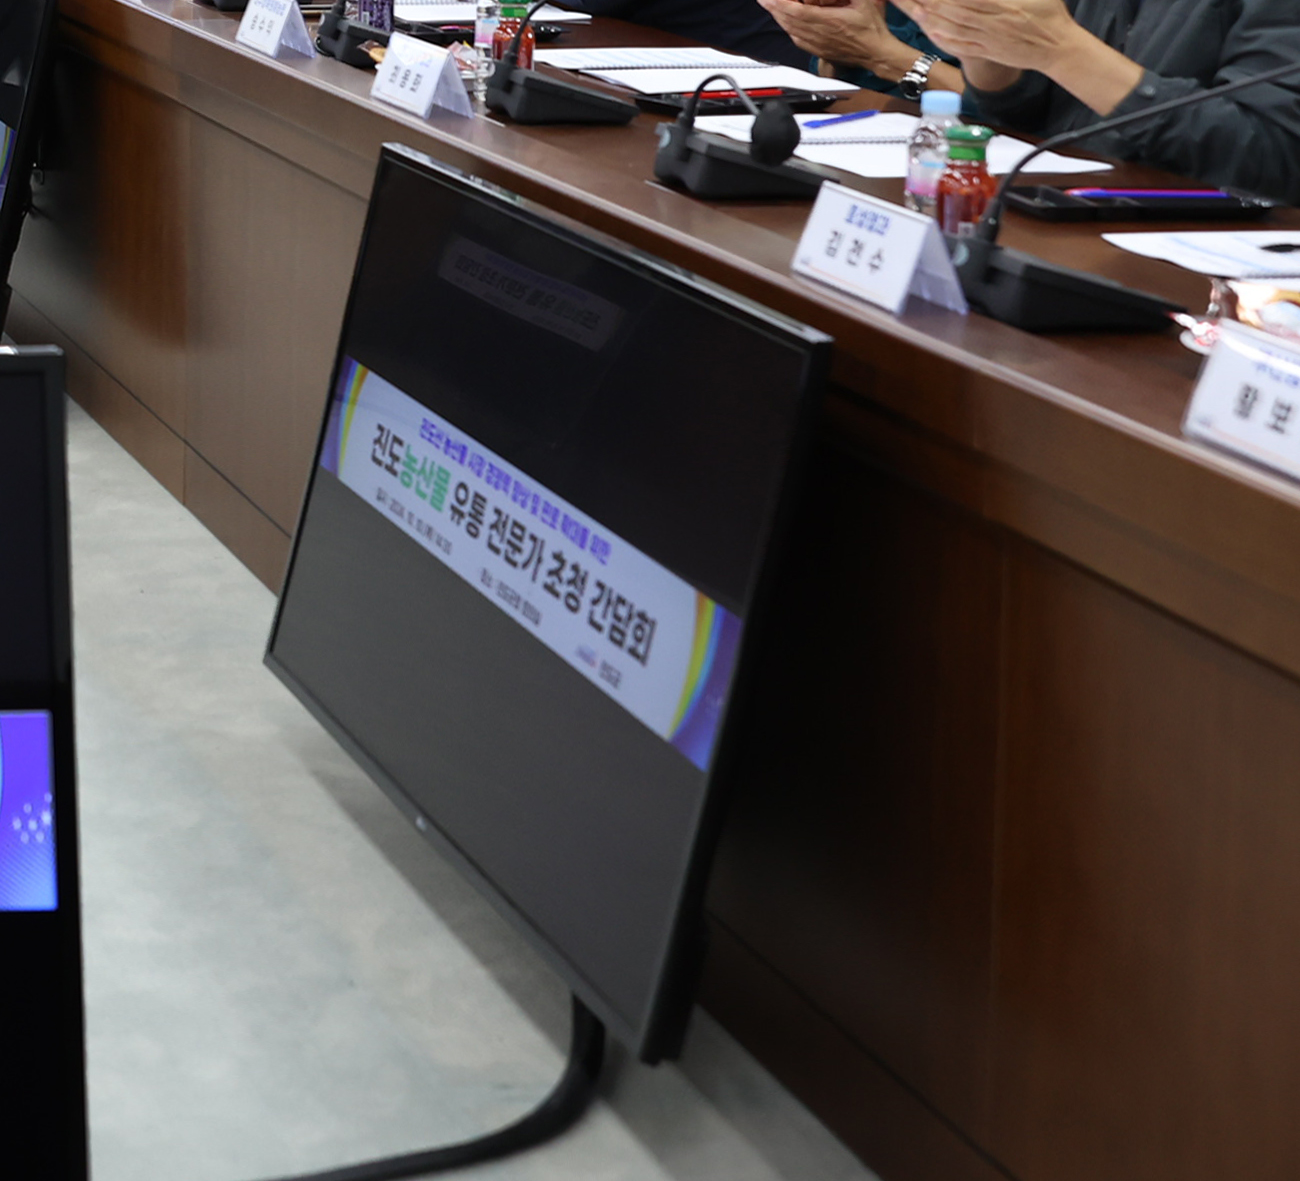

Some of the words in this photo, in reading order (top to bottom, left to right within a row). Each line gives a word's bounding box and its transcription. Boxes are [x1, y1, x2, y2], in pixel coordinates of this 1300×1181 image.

[448, 480, 487, 541] 유통
[486, 507, 545, 583] 전문가
[543, 547, 588, 616] 초청
[587, 579, 656, 667] 간담회
